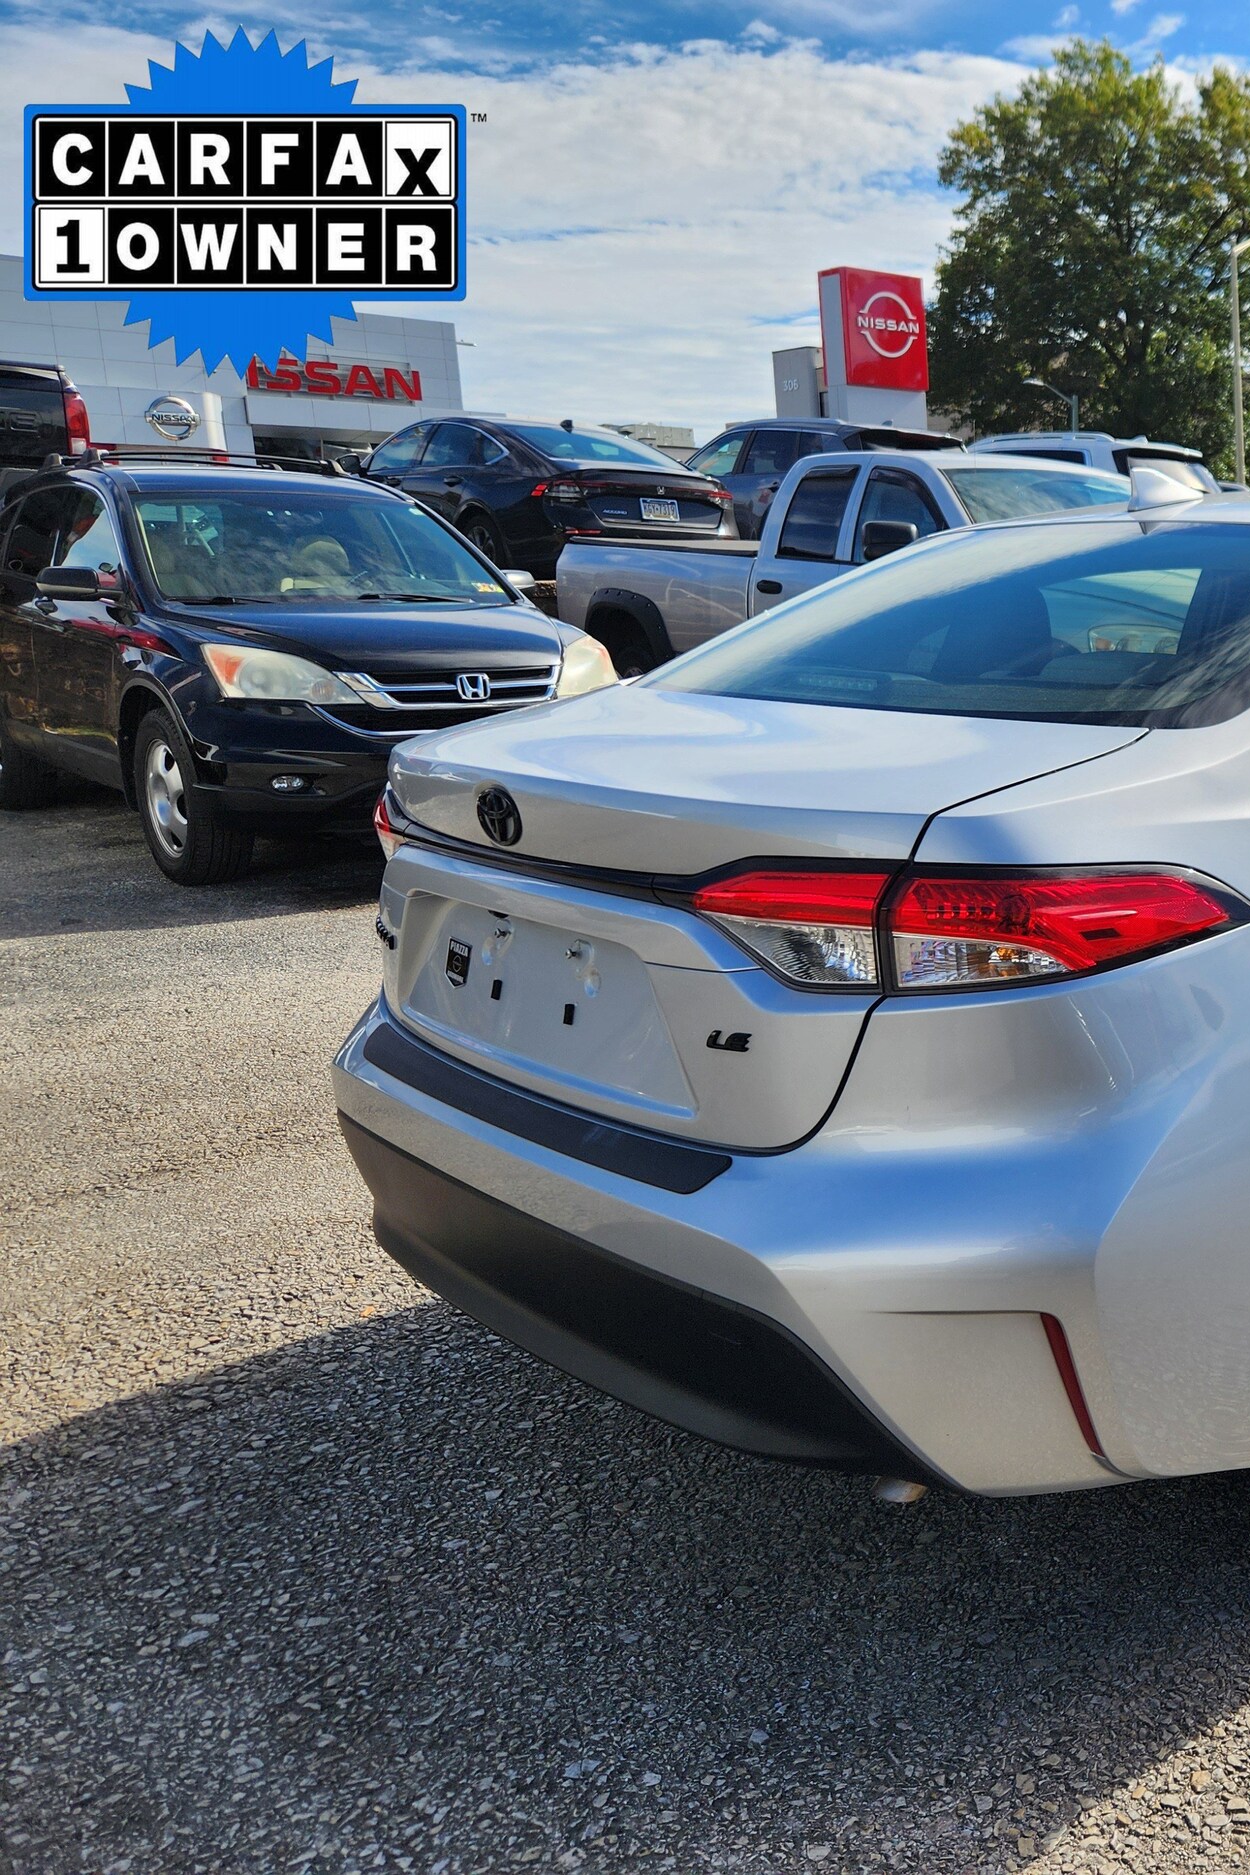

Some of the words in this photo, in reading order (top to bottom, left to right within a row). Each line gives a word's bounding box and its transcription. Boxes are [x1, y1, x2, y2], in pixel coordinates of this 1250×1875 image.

[857, 315, 920, 334] NISSAN
[246, 354, 423, 402] ISSAN
[783, 378, 799, 392] 306
[151, 413, 197, 424] NISSAN
[706, 1029, 752, 1053] LE
